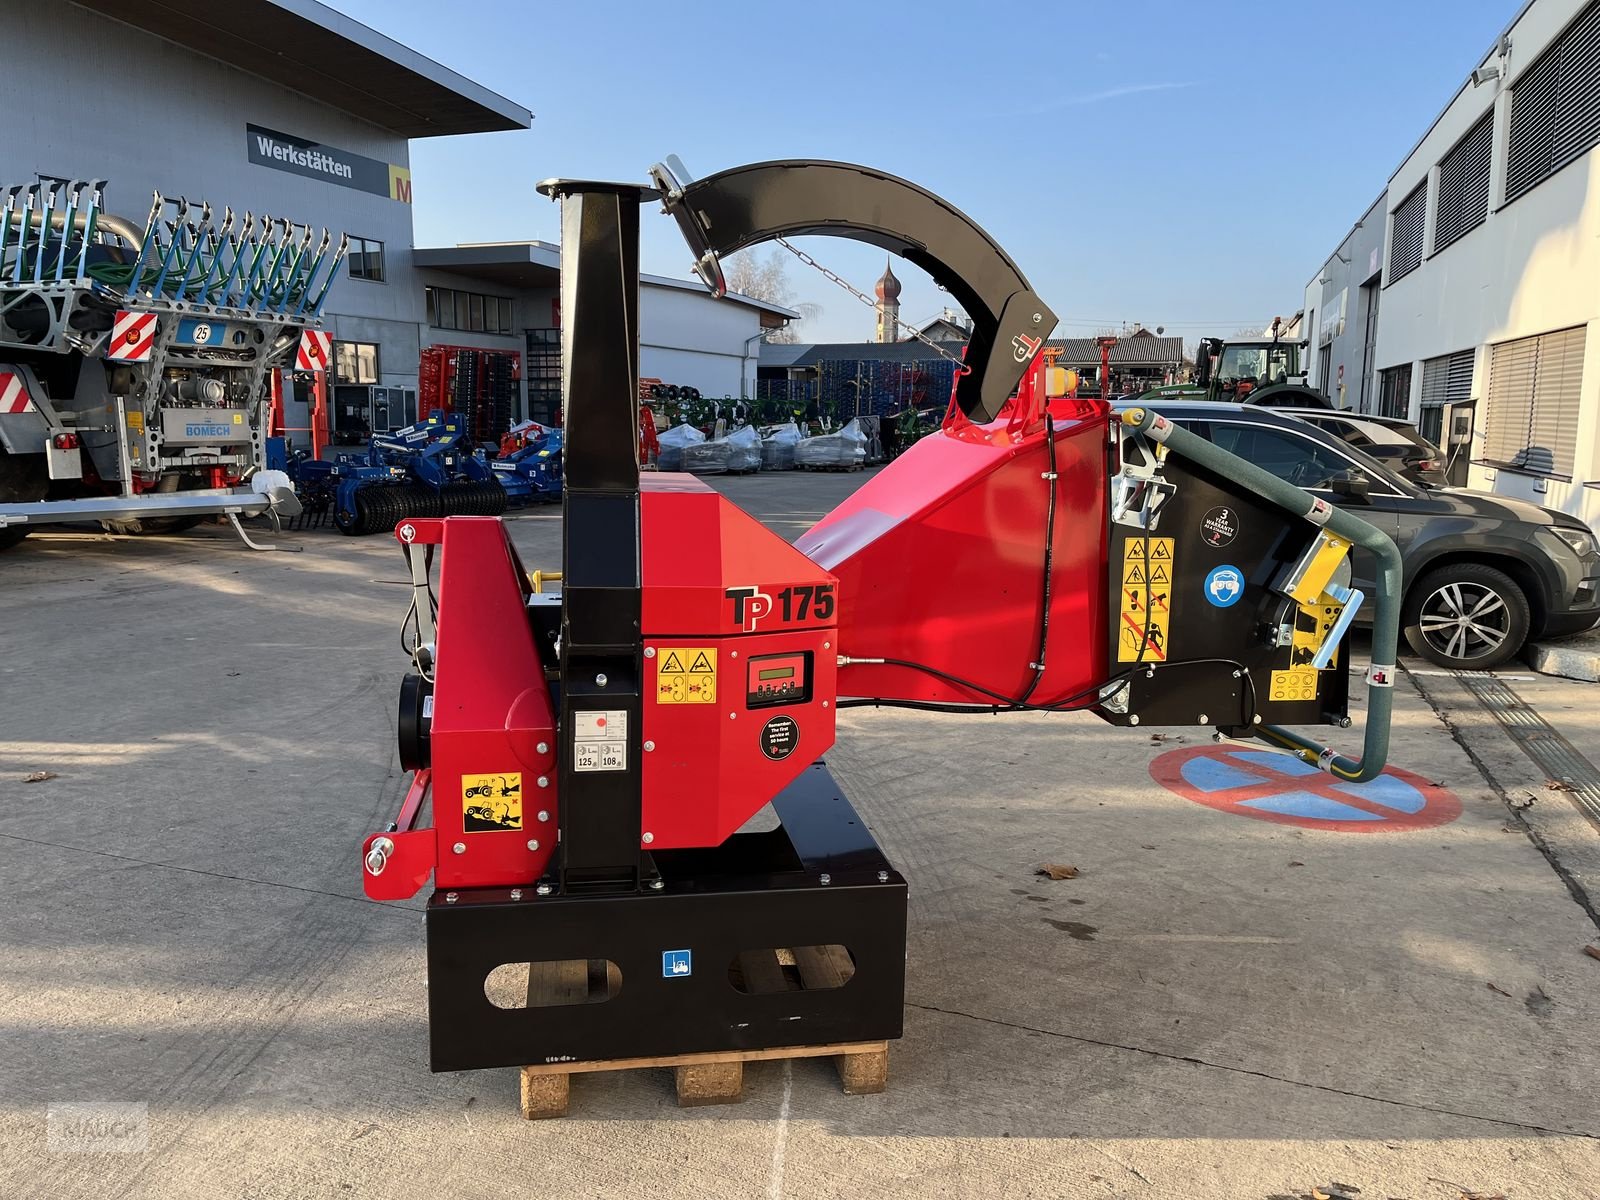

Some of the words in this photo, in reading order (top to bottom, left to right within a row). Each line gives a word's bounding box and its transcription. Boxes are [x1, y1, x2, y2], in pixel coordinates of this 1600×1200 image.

[256, 135, 352, 179] Werkstätten
[196, 328, 208, 339] 25
[1011, 333, 1042, 363] TP
[186, 426, 230, 436] BOMECH
[1220, 509, 1228, 519] 3
[1206, 519, 1234, 532] WARRANTY
[1216, 517, 1228, 526] YEAR
[725, 585, 773, 633] TP
[778, 584, 834, 622] 175
[579, 757, 592, 766] 125
[603, 757, 617, 766] 108
